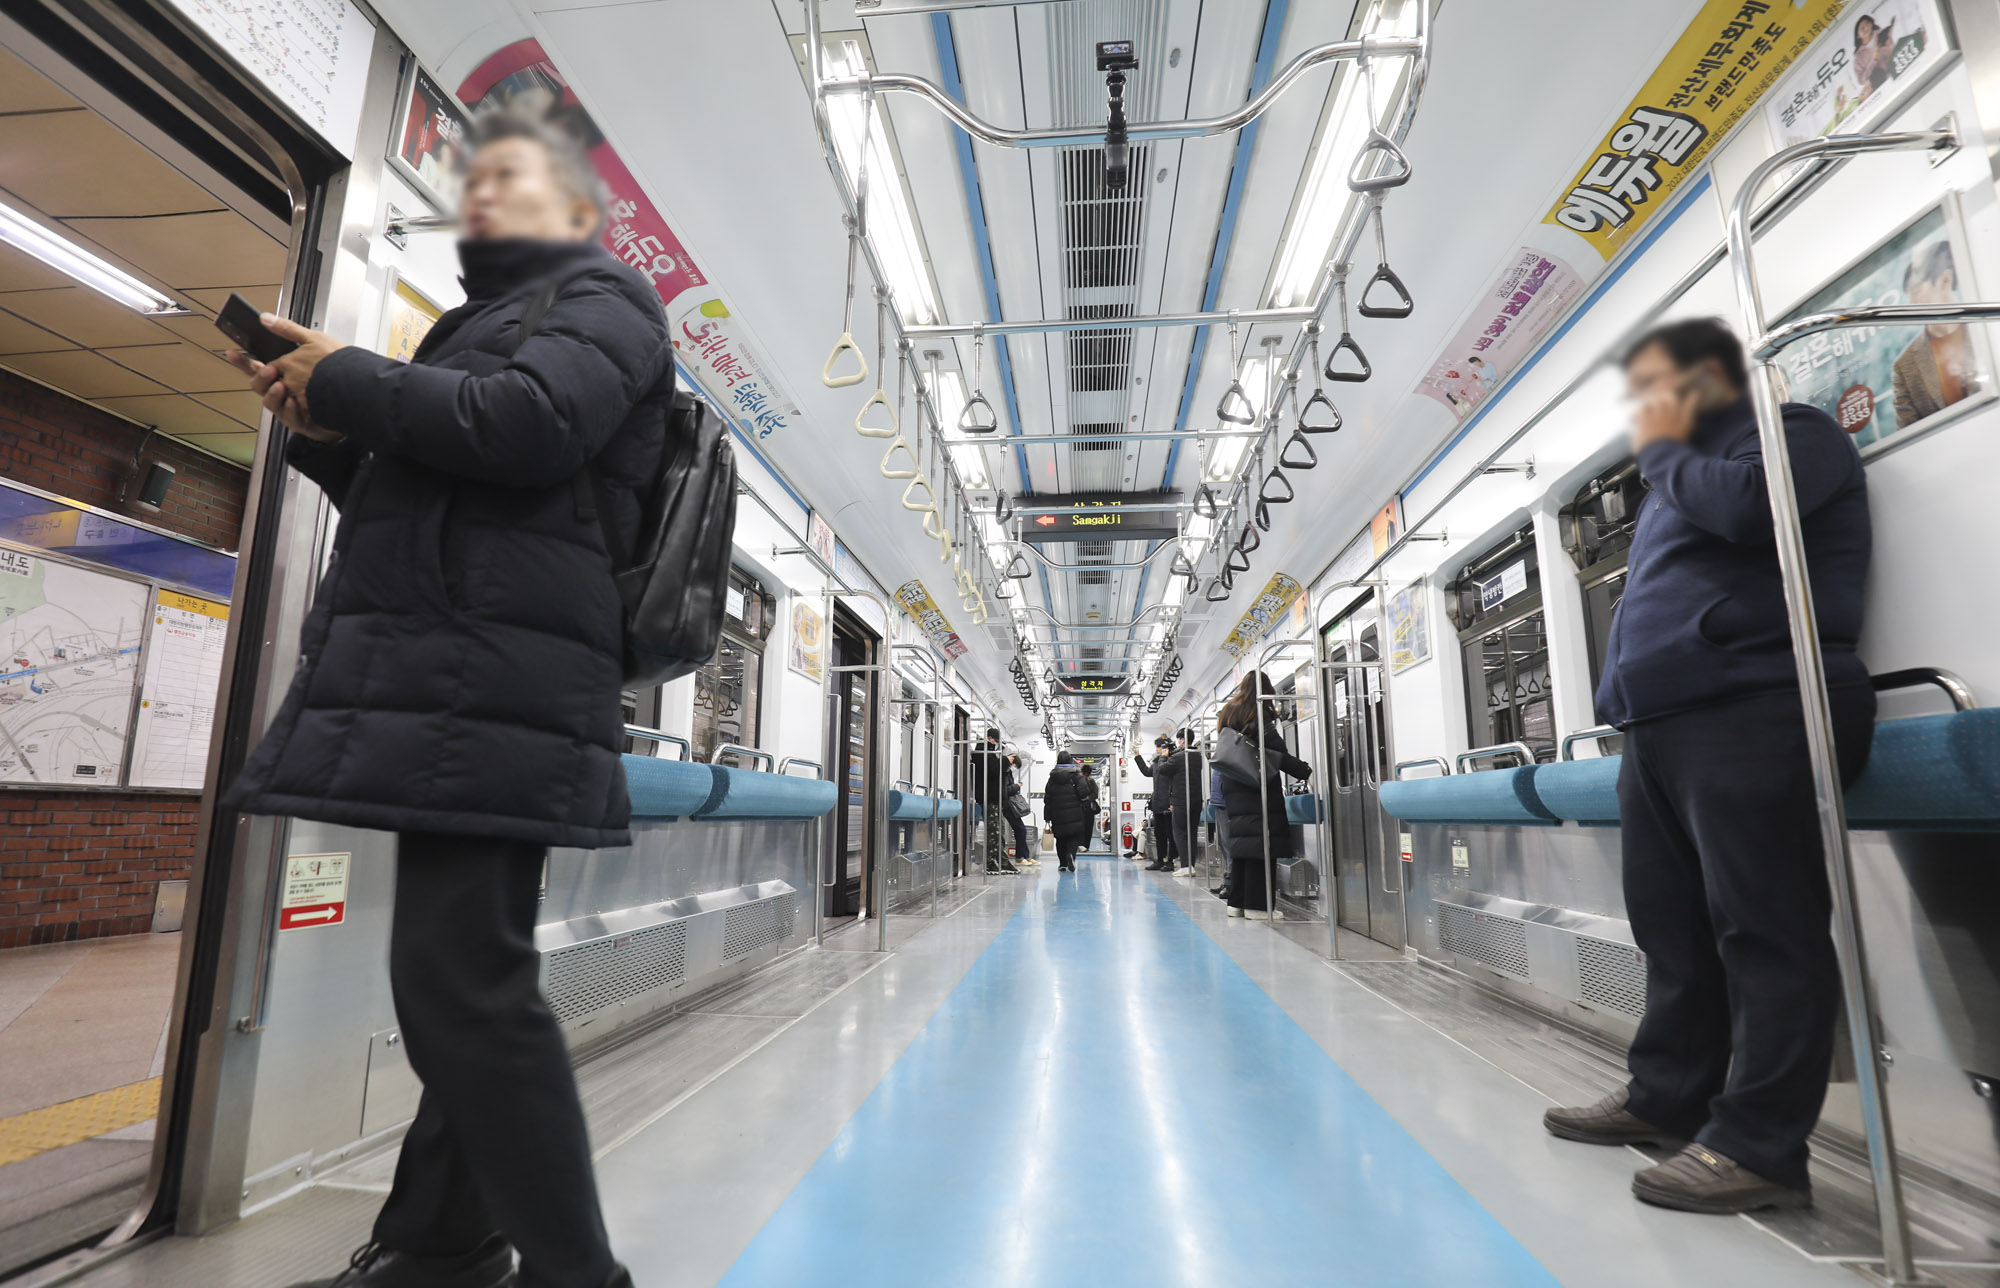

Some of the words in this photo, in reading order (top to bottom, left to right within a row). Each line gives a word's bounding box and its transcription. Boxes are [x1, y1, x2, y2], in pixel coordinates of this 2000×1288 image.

[1665, 0, 1771, 108] 전산세무회계
[1704, 22, 1787, 112] 브랜드만족도
[1781, 48, 1849, 128] 결혼해듀오
[1666, 172, 1683, 191] 2022
[1682, 146, 1707, 174] 대한민국
[1706, 104, 1747, 146] 브랜드만족도
[1743, 56, 1792, 102] 전산세무회계
[1791, 36, 1809, 57] 교육
[1555, 106, 1709, 233] 에듀윌
[1841, 397, 1870, 421] 1577
[1072, 514, 1121, 526] Samgakji
